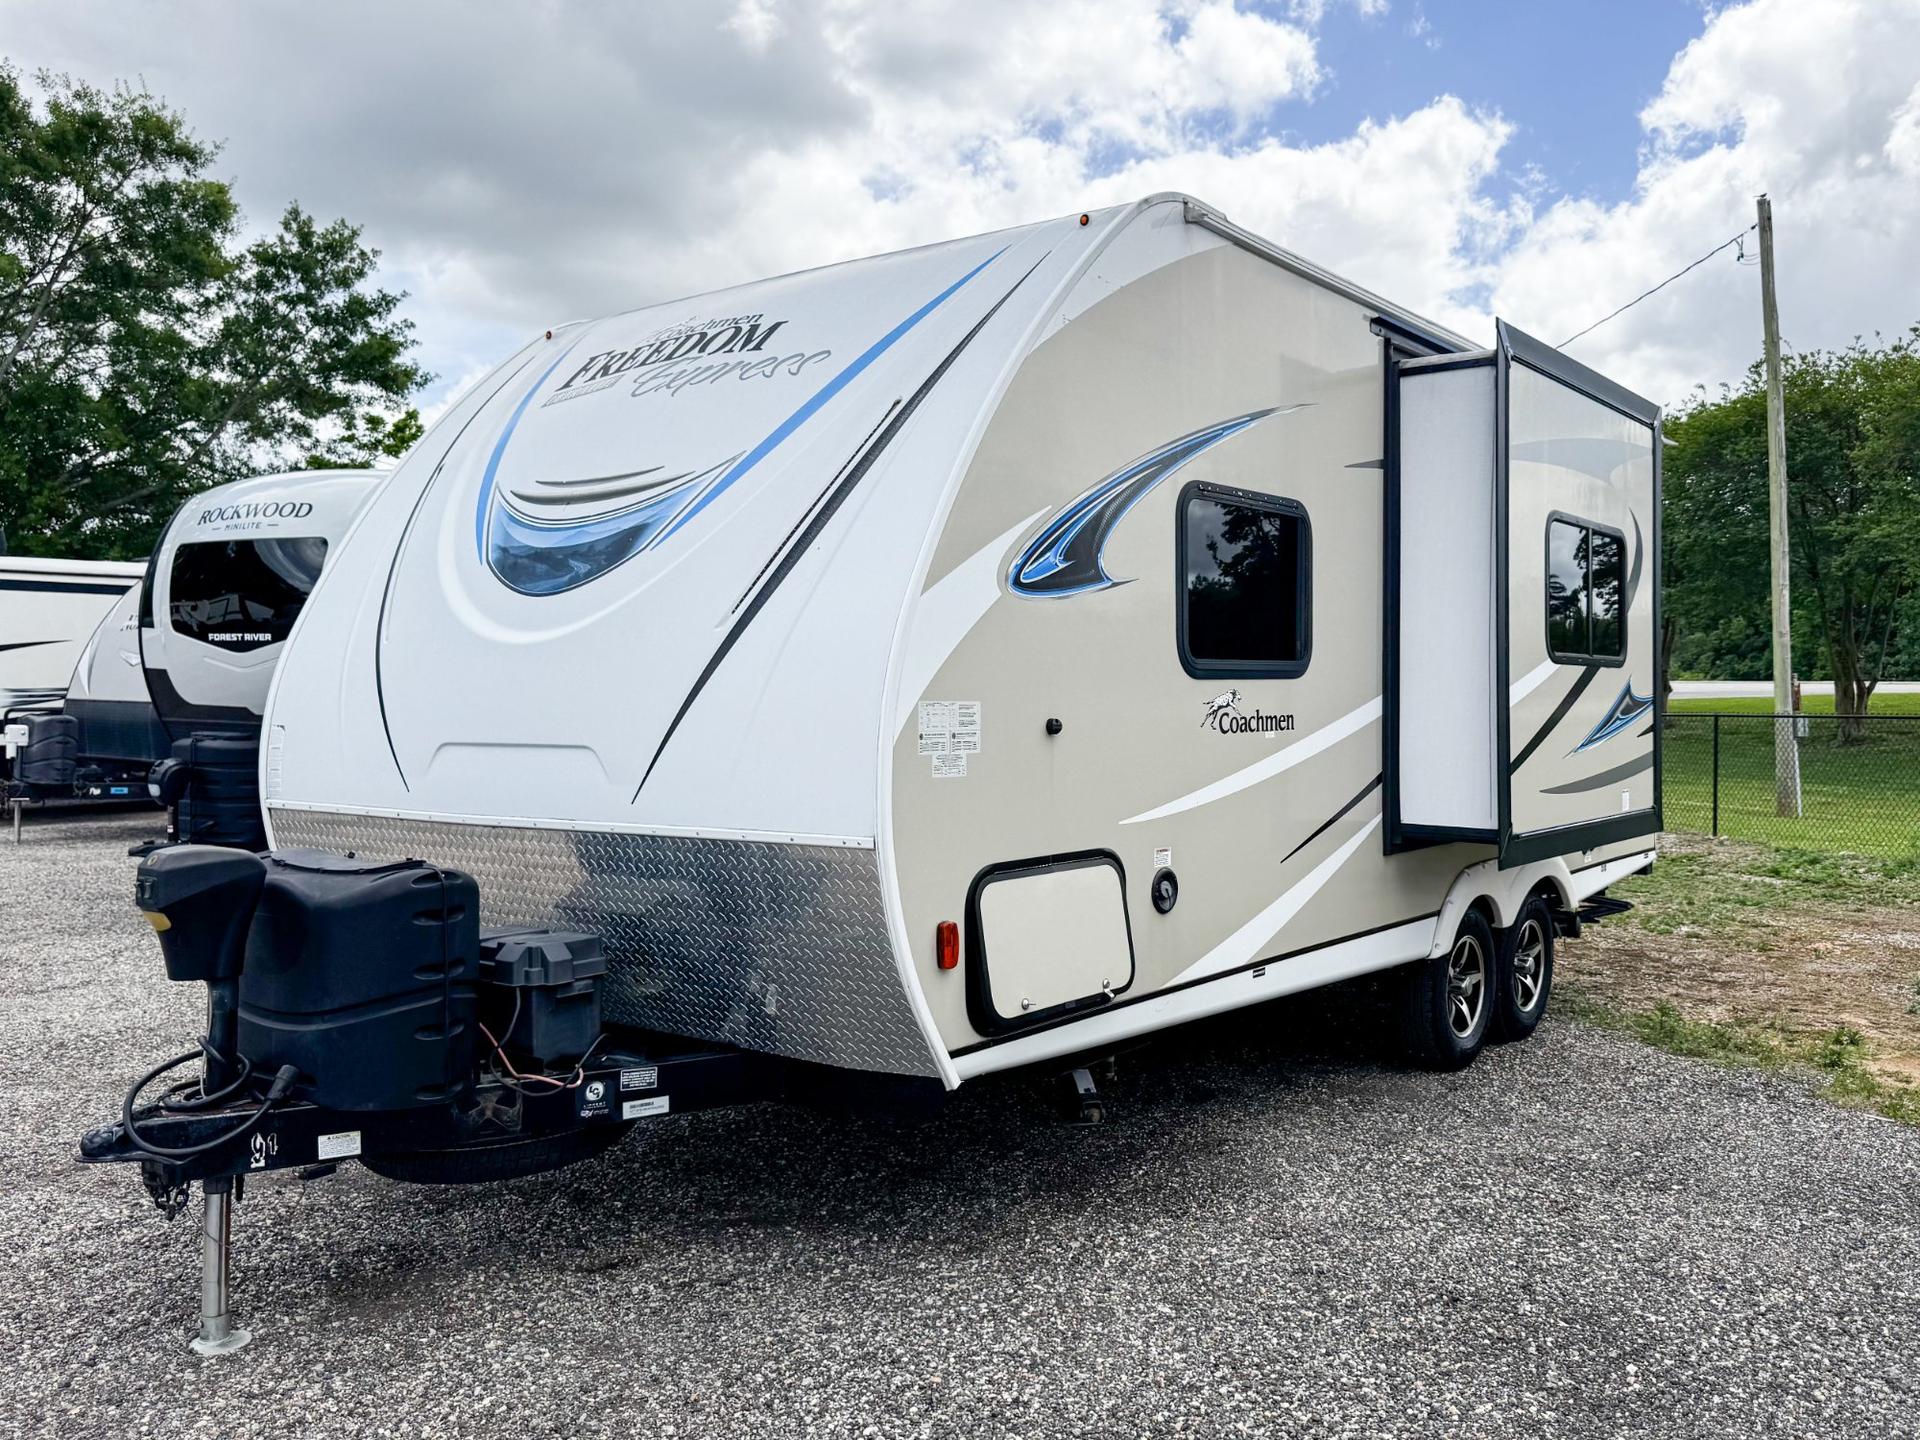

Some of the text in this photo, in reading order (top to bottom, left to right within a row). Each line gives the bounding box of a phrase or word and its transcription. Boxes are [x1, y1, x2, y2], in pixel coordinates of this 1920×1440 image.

[654, 313, 764, 342] Coachmen
[556, 320, 788, 391] FREEDOM
[631, 349, 831, 397] Express
[197, 502, 313, 526] ROCKWOOD
[224, 522, 262, 531] MINILITE
[208, 633, 272, 641] FOREST RIVER
[1219, 709, 1295, 734] Coachmen
